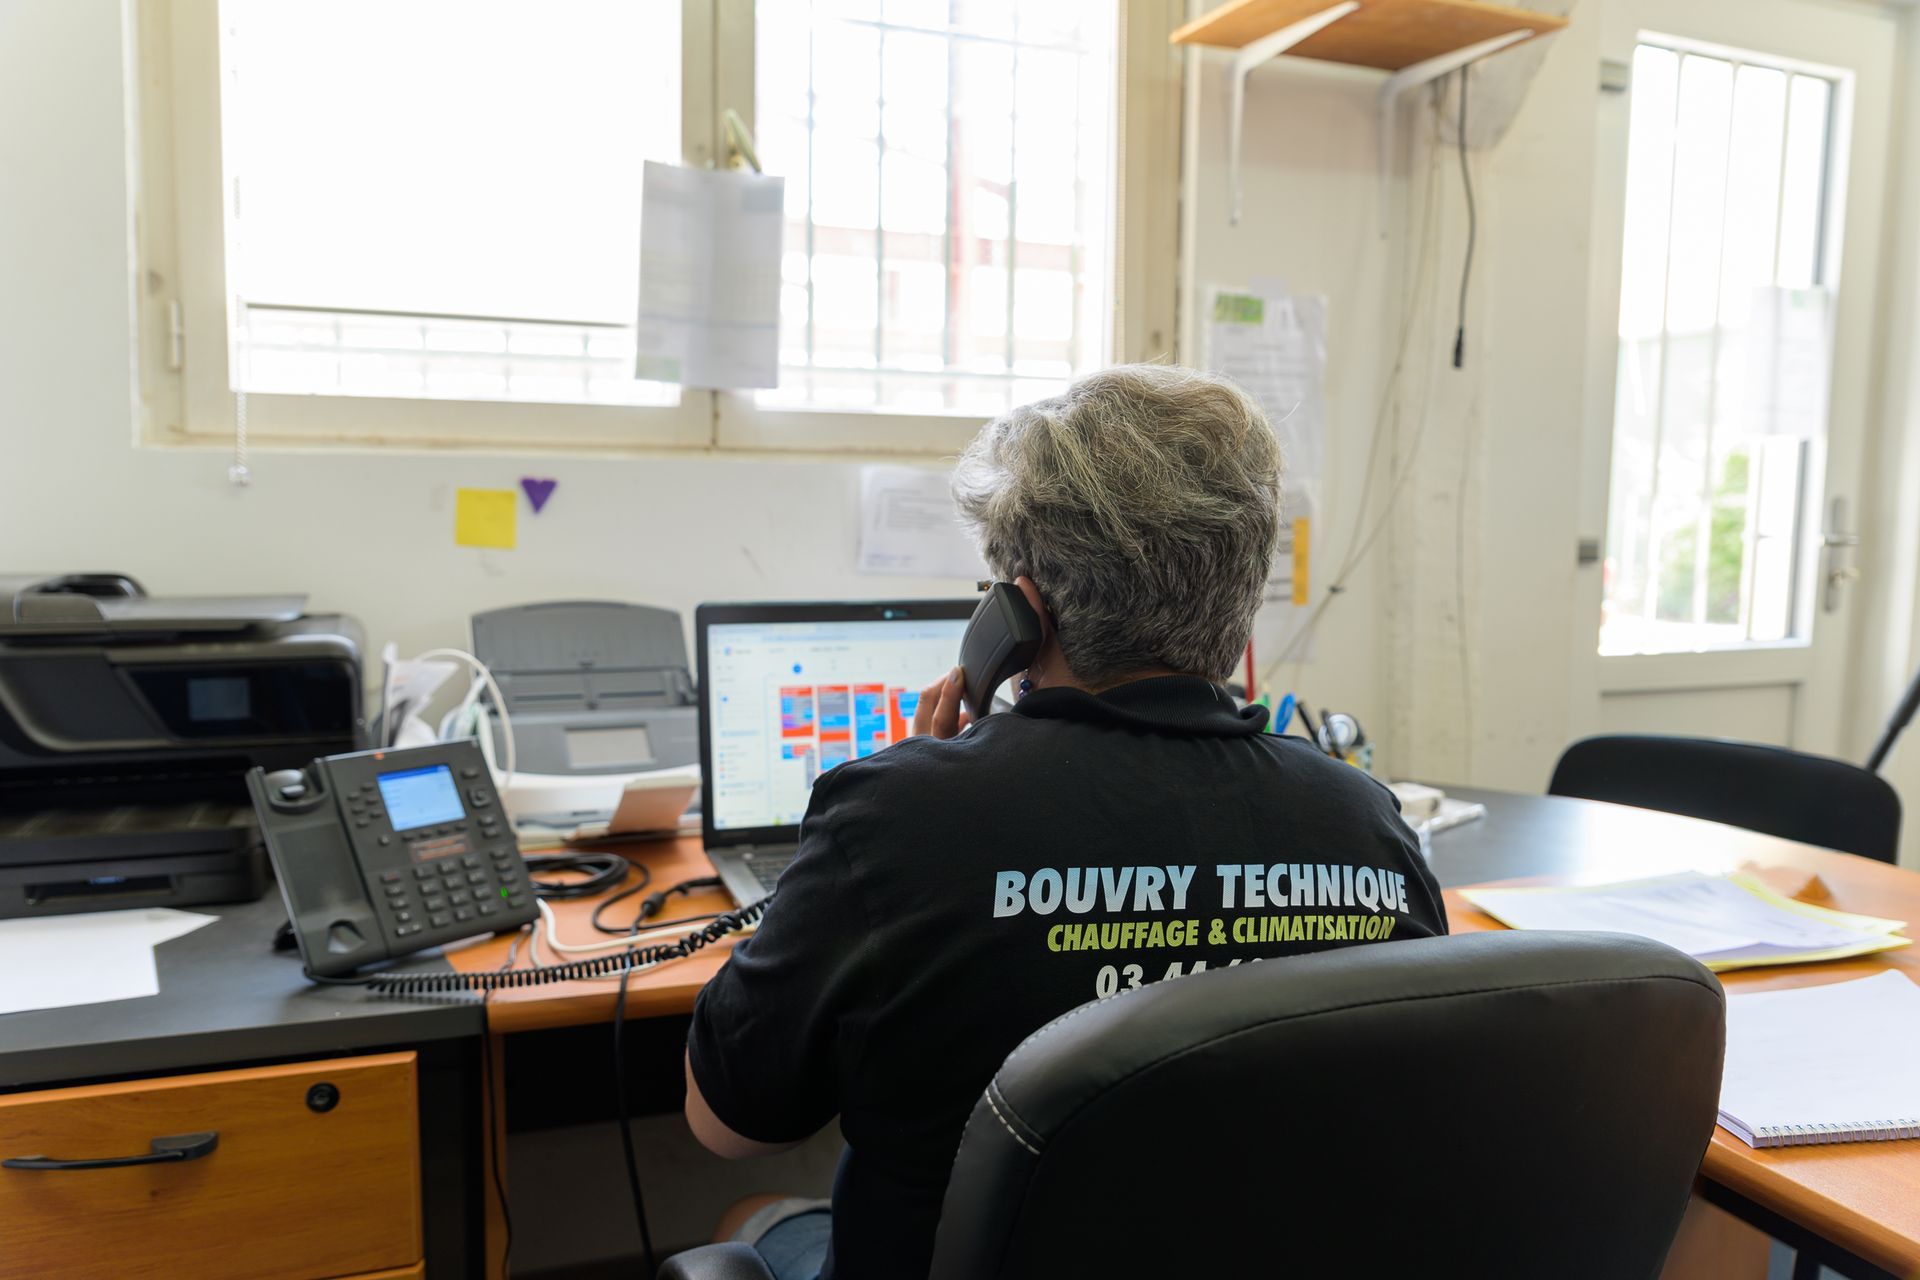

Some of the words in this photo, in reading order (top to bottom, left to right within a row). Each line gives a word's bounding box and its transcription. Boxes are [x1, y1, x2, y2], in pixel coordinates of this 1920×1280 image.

[993, 865, 1197, 918] BOUVRY
[1216, 863, 1409, 914] TECHNIQUE
[1047, 919, 1200, 952] CHAUFFAGE
[1207, 918, 1228, 945] &
[1232, 915, 1396, 944] CLIMATISATION
[1096, 963, 1144, 1000] 03
